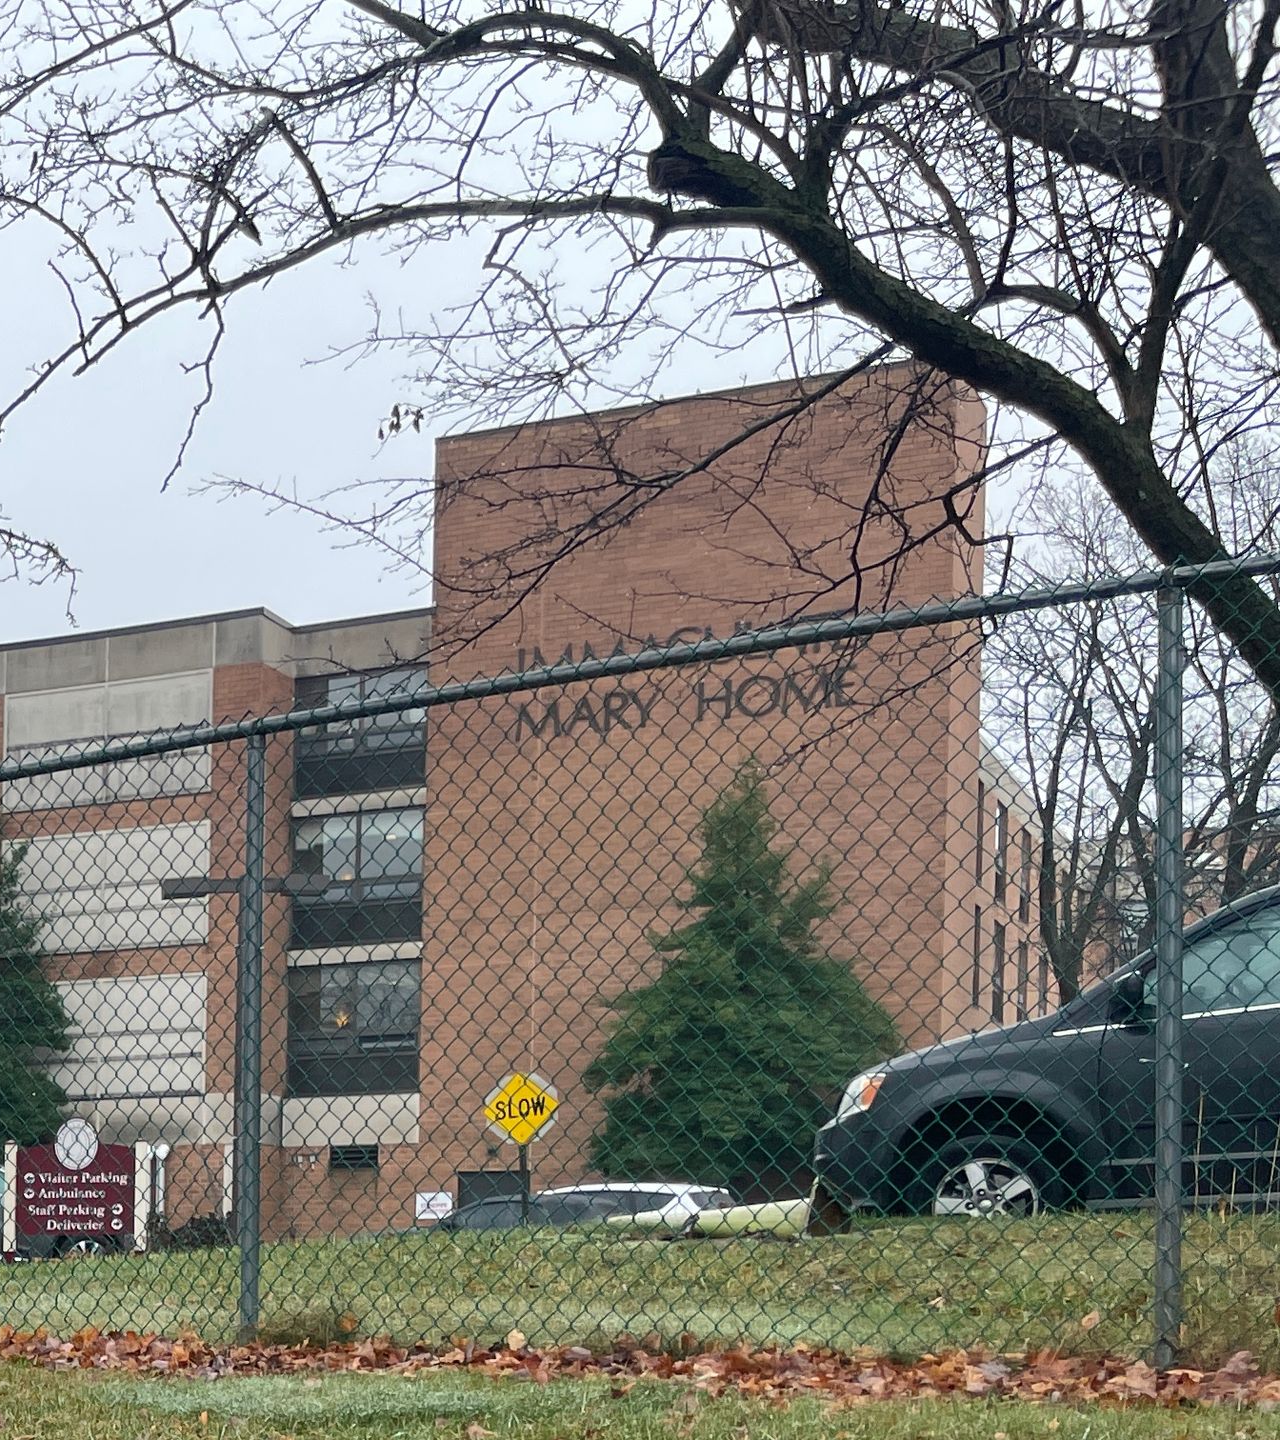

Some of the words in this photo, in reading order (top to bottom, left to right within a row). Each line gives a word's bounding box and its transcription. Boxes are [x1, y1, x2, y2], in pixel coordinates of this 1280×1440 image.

[515, 689, 662, 743] MARY
[696, 662, 857, 722] HOME
[495, 1095, 546, 1120] SLOW
[38, 1172, 78, 1184] Visitor
[81, 1171, 128, 1186] Parking
[38, 1187, 107, 1199] Ambulance
[28, 1203, 57, 1216] Staff
[58, 1203, 106, 1218] Parking
